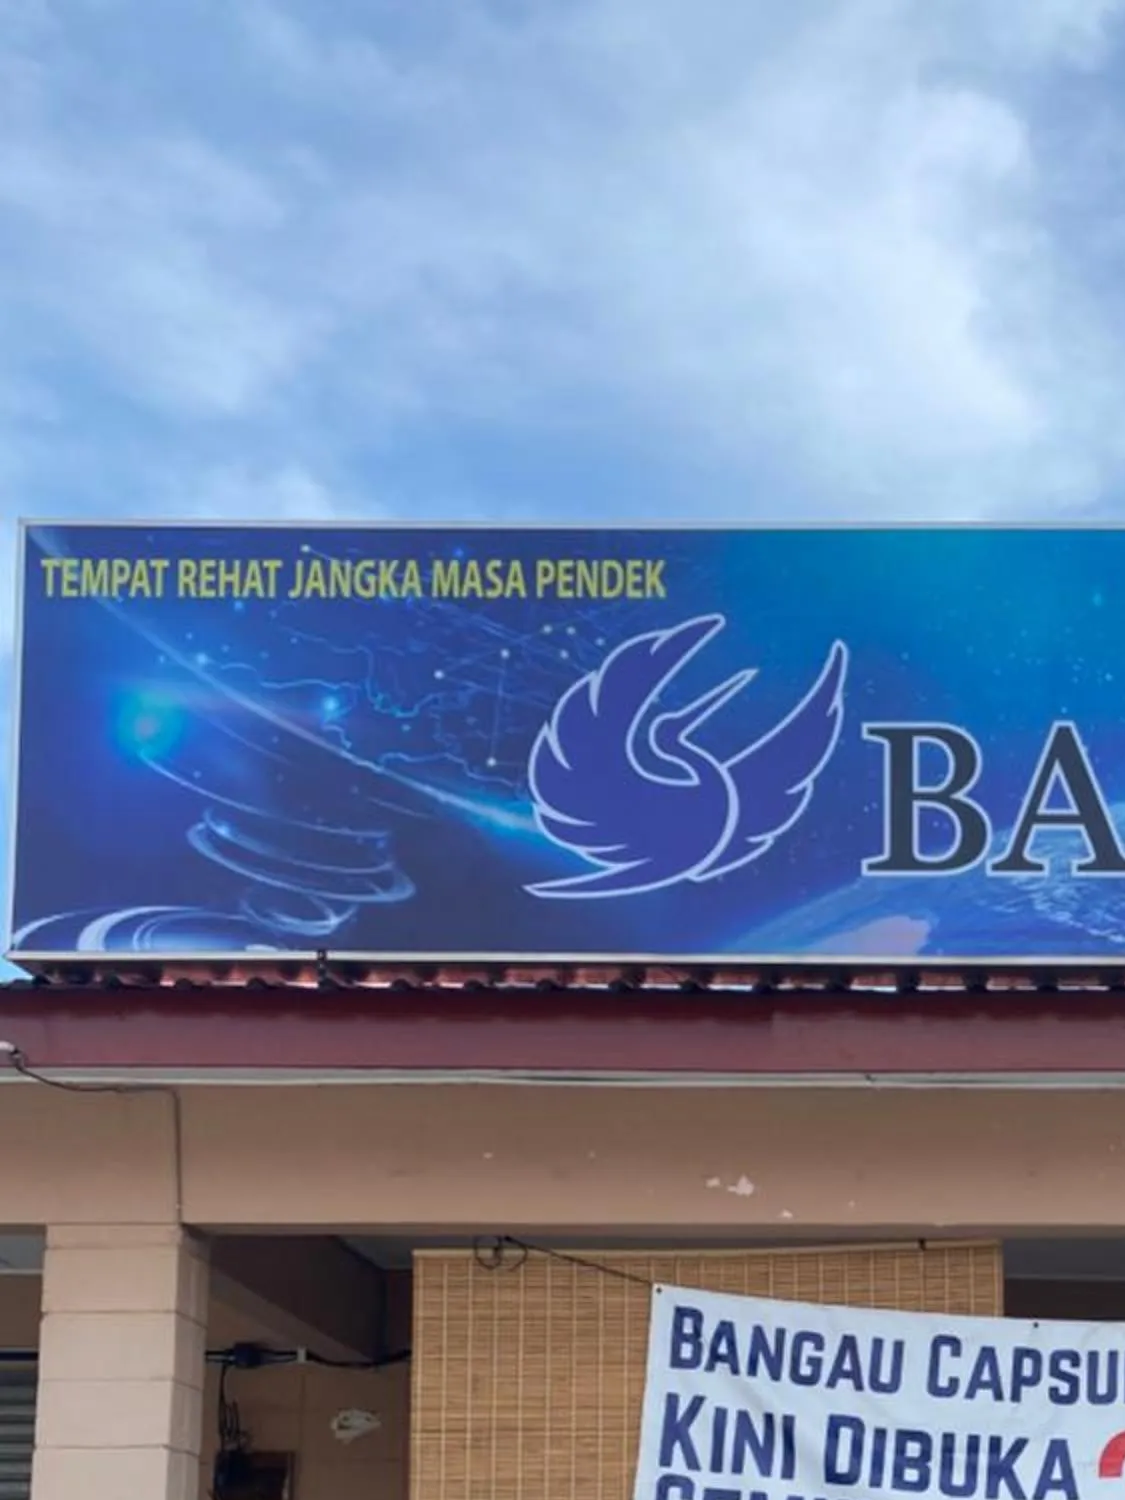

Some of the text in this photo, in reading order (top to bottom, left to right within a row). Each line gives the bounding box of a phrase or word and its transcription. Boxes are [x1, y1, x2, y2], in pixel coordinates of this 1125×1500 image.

[41, 557, 667, 599] TEMPAT REHAT JANGKA MASA PENDEK
[669, 1306, 906, 1395] BANGAU
[658, 1392, 796, 1480] KINI
